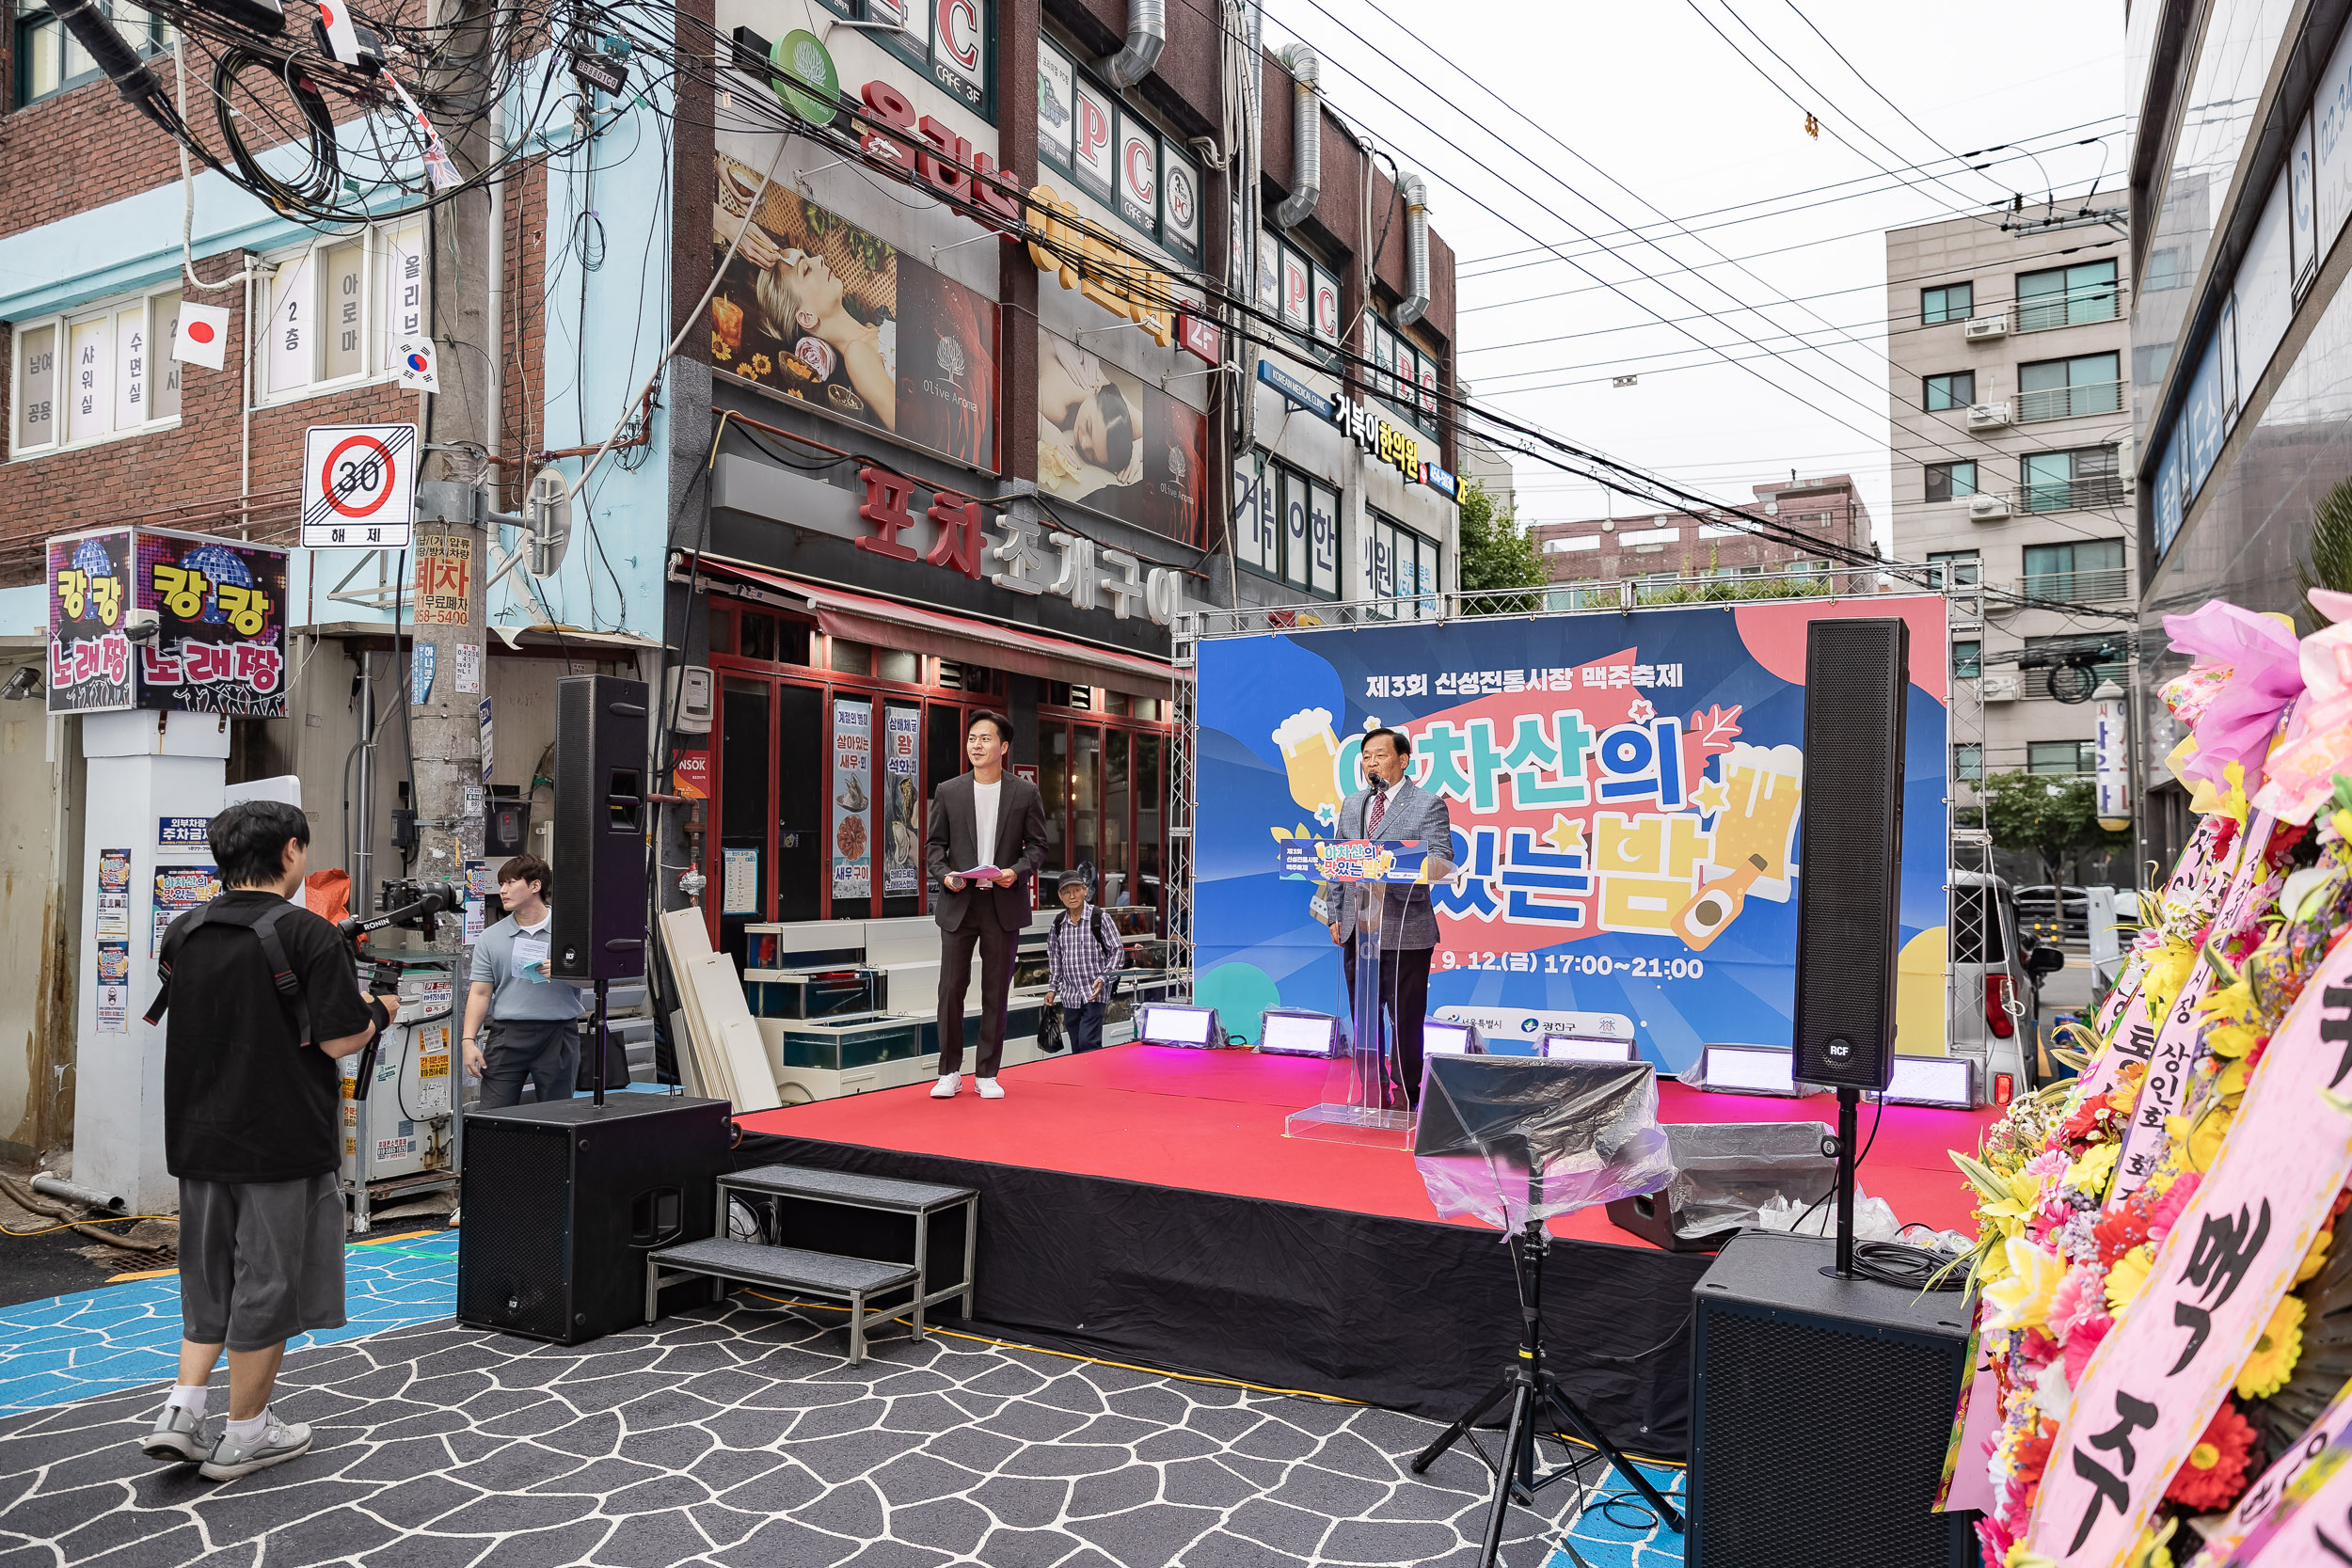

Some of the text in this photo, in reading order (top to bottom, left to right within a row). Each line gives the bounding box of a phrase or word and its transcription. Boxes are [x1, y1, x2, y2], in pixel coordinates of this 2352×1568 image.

[935, 64, 980, 103] CAFE 3F
[1124, 200, 1155, 231] CAFE 3F
[404, 255, 421, 336] 올리브
[342, 273, 358, 352] 아로마
[285, 301, 299, 351] 2층
[29, 352, 53, 375] 남여
[167, 318, 180, 391] 2시
[128, 332, 142, 404] 수면실
[81, 345, 95, 415] 샤워실
[1272, 369, 1327, 412] KOREAN MEDICAL CLINIC
[923, 378, 978, 414] Olive Aroma
[28, 401, 52, 423] 공용
[1335, 392, 1419, 480] 거북이한의원
[339, 461, 380, 492] 30
[1160, 483, 1195, 506] Olive Aroma
[1366, 662, 1683, 698] 제3회 신성전통시장 맥주축제
[838, 711, 857, 725] 계절의
[836, 735, 869, 752] 살아있는
[898, 735, 913, 755] 왕
[170, 819, 207, 828] 외부차량
[1324, 844, 1377, 861] 아차산의
[835, 866, 869, 880] 새우 구이
[1324, 860, 1381, 878] 맛있는 밤
[1597, 811, 1717, 933] 밤
[164, 876, 208, 888] 아차산의
[164, 888, 197, 901] 맛있는
[364, 918, 390, 931] RONIN
[1544, 953, 1705, 980] 17:00~21:00
[1461, 1017, 1577, 1033] 서울특별시 광진구
[1830, 1045, 1849, 1055] RCF
[508, 1300, 517, 1308] RCF
